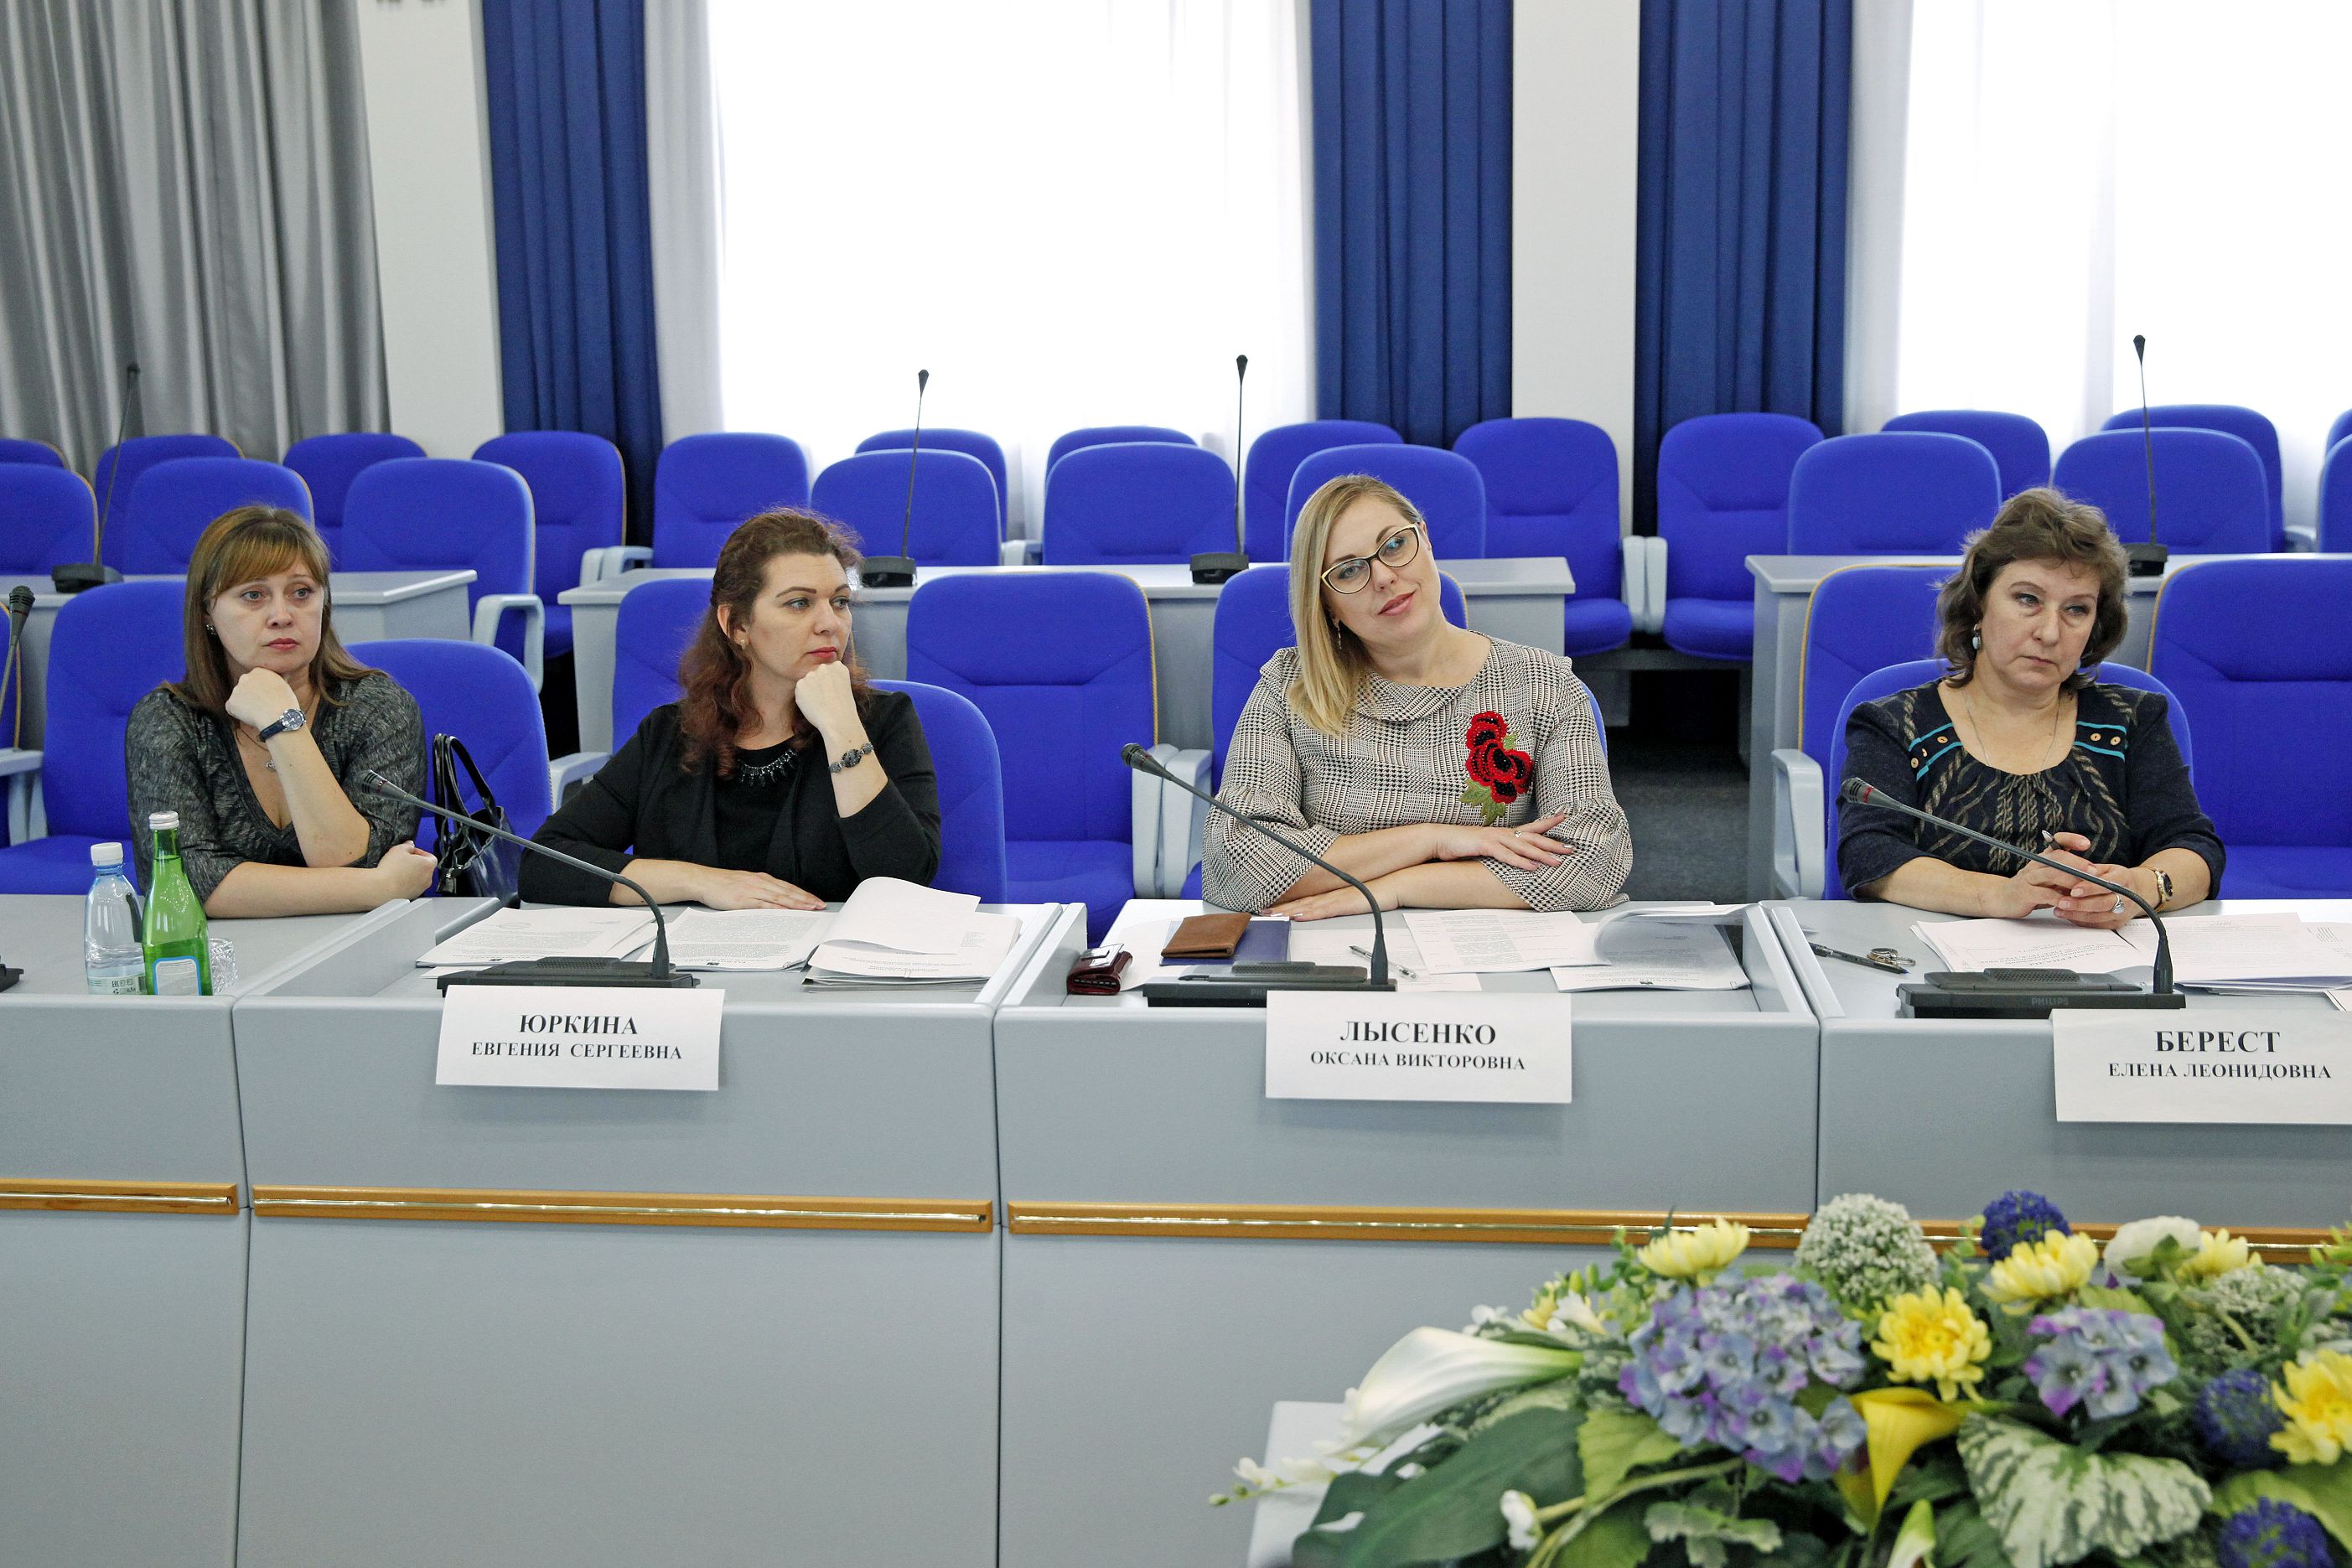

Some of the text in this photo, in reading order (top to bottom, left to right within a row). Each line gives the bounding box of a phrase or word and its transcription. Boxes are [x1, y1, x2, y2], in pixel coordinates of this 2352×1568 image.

[2031, 996, 2069, 1006] PHILIPS
[518, 1014, 639, 1036] ЮРКИНА
[1339, 1021, 1498, 1045] ЛЫСЕНКО
[471, 1041, 683, 1060] ЕВГЕНИЯ СЕРГЕЕВНА
[2155, 1030, 2282, 1053] БЕРЕСТ
[1309, 1051, 1526, 1071] ОКСАНА ВИКТОРОВНА
[2108, 1062, 2333, 1081] ЕЛЕНА ЛЕОНИДОВНА
